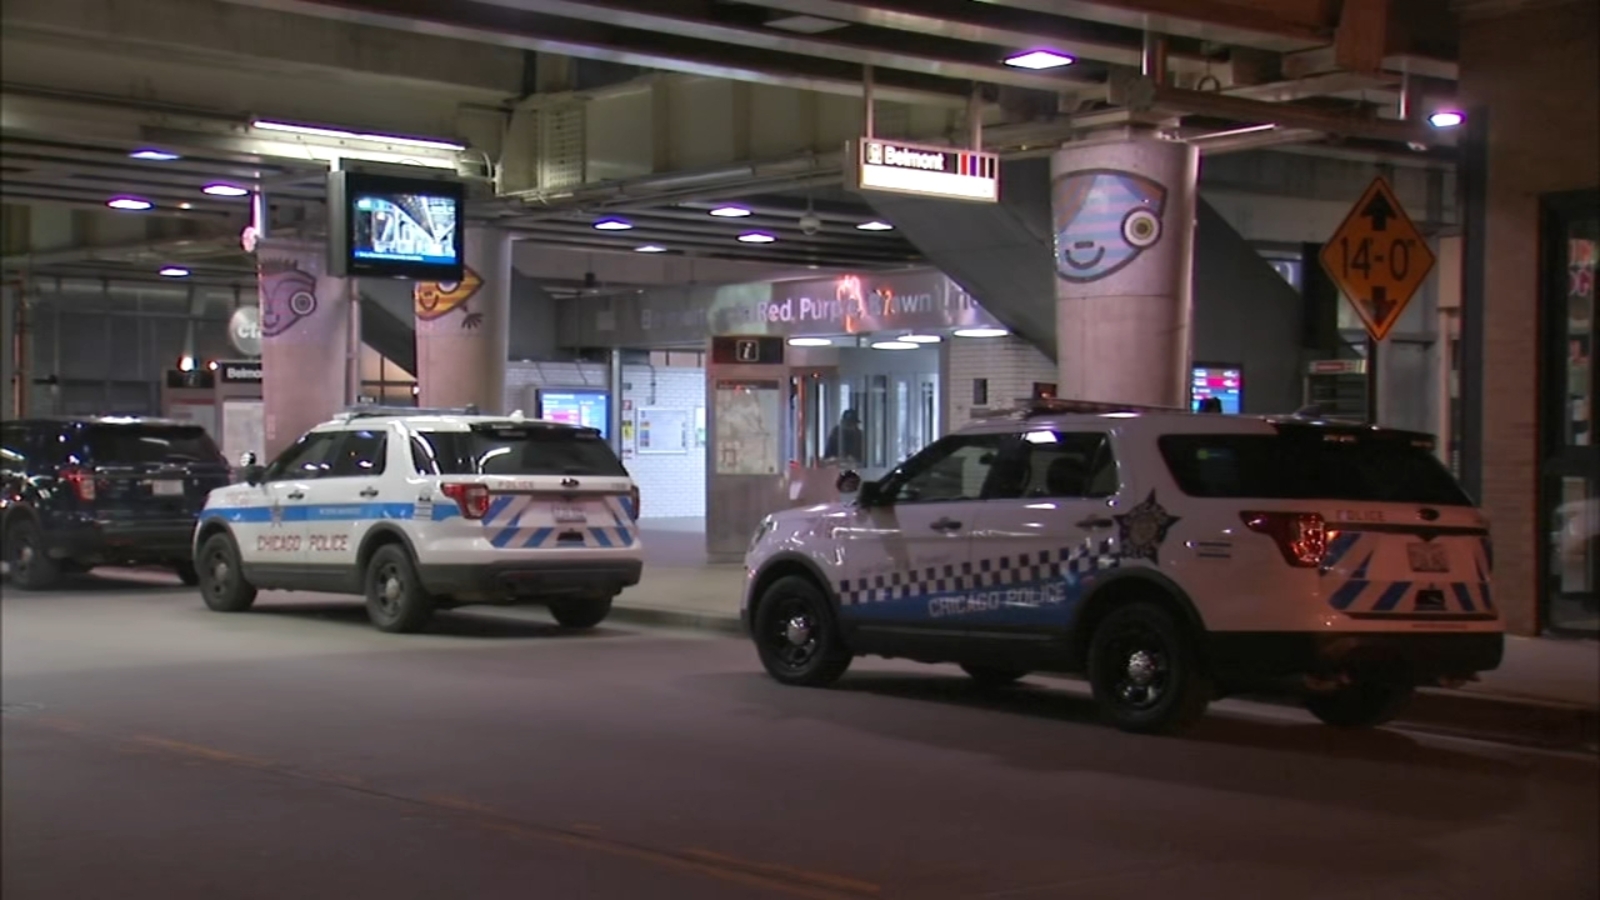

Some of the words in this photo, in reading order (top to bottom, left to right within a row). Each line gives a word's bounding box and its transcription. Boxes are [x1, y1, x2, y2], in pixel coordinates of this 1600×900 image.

[884, 144, 944, 171] Belmont
[257, 534, 301, 551] CHICAGO
[309, 533, 348, 551] POLICE
[928, 591, 1000, 617] CHICAGO
[1005, 581, 1067, 607] POLICE
